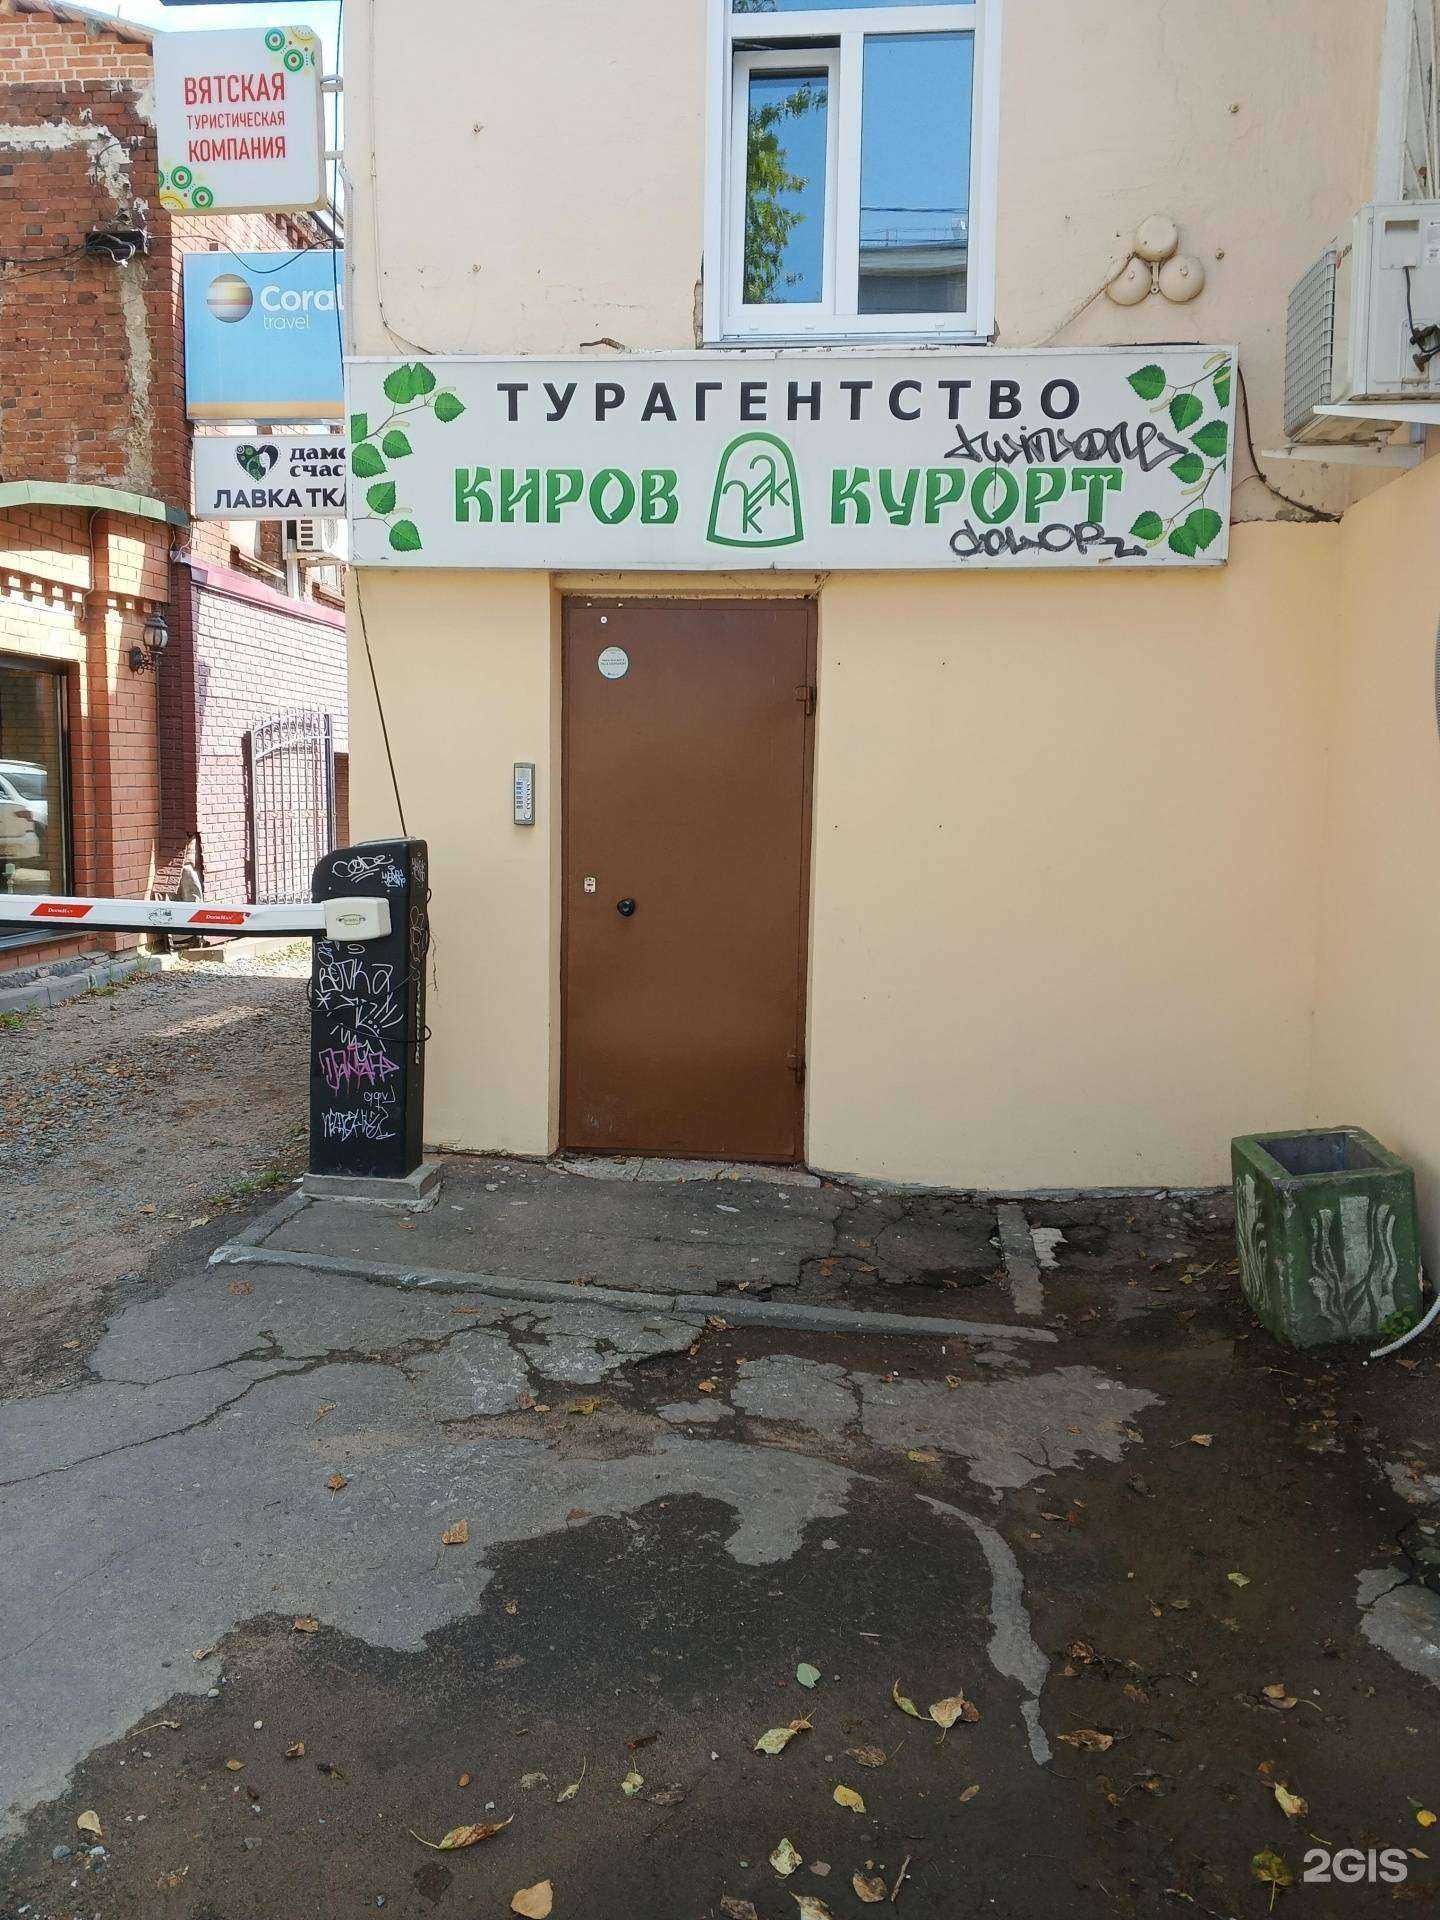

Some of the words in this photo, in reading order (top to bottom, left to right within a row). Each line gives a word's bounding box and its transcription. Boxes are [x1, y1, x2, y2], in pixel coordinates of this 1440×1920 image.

[184, 72, 285, 105] ВЯТСКАЯ
[187, 111, 286, 130] ТУРИСТИЧЕСКАЯ
[188, 136, 286, 162] КОМПАНИЯ
[260, 283, 344, 312] Coral
[263, 314, 310, 330] travel
[496, 378, 1080, 423] ТУРАГЕНТСТВО
[289, 464, 346, 477] счас
[213, 488, 303, 509] ЛАВКА
[455, 466, 679, 525] КИРОВ
[830, 466, 1123, 525] КУРОРТ
